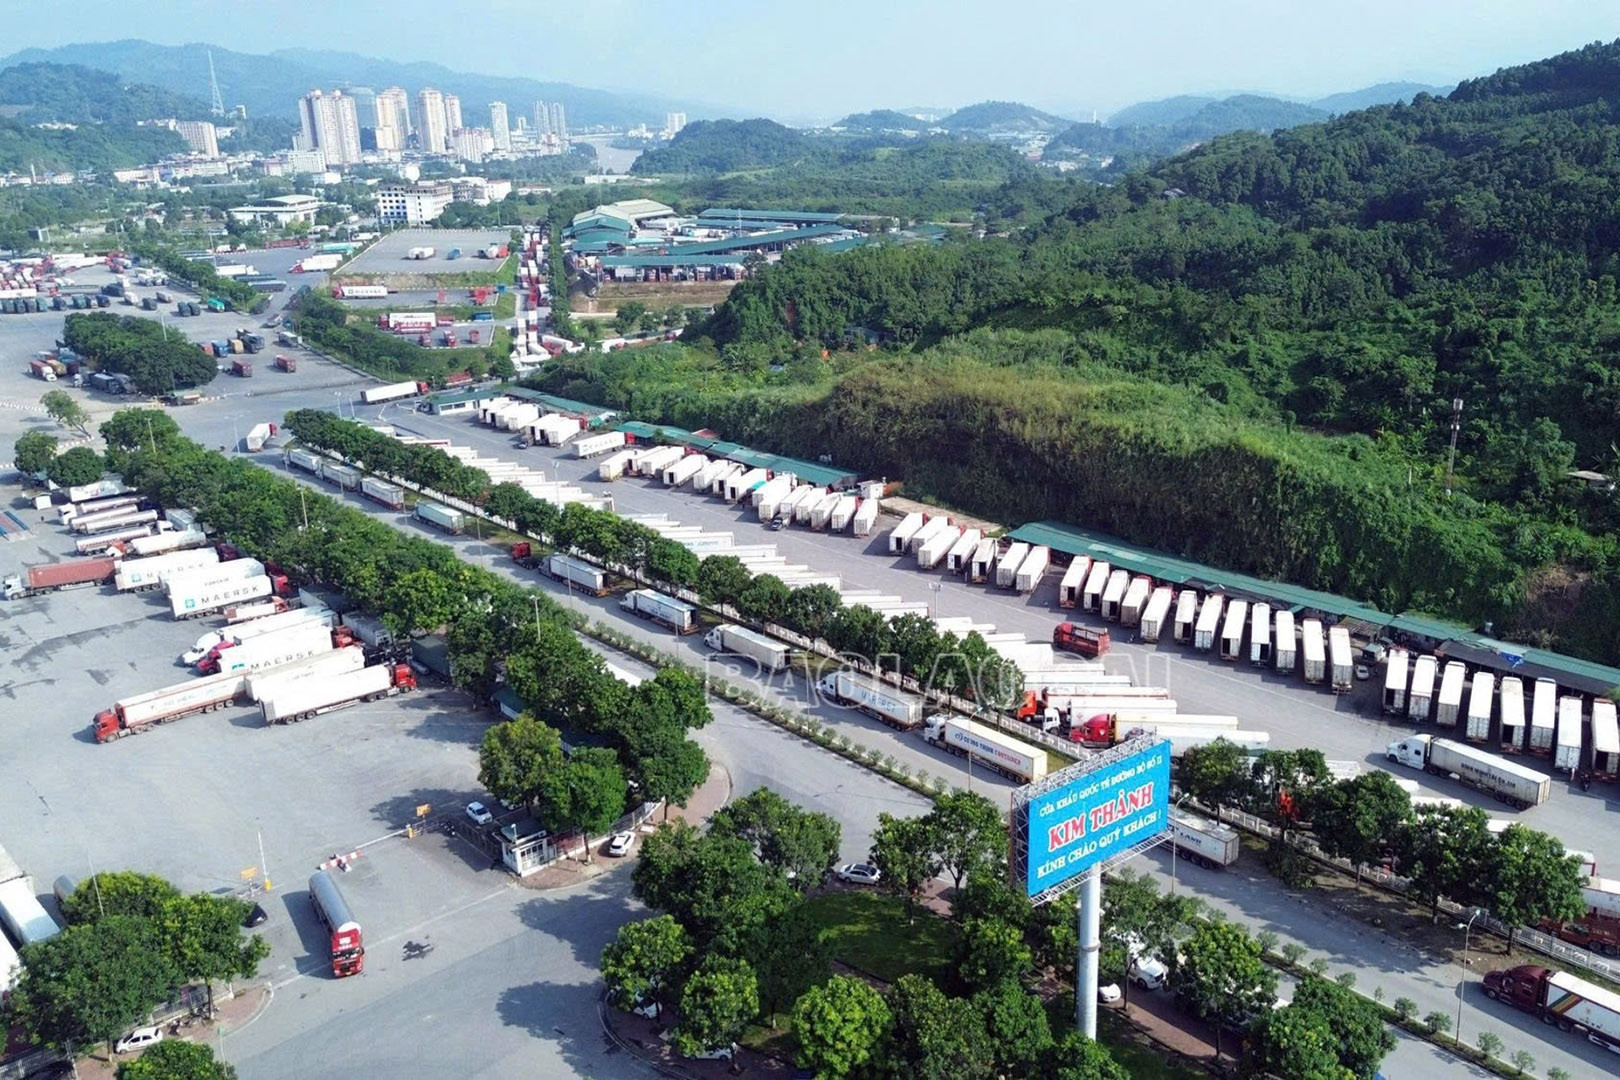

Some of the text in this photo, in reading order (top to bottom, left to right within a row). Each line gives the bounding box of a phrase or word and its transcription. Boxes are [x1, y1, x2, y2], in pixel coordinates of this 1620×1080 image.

[201, 585, 259, 604] MAERSK
[250, 650, 315, 670] MAERSK
[1039, 800, 1055, 817] CỬA
[1080, 782, 1099, 799] QUỐC
[1100, 776, 1111, 790] TẾ
[1036, 855, 1066, 879] KÍNH
[1067, 840, 1097, 863] CHÀO
[1098, 826, 1121, 848] QUÝ
[1123, 811, 1158, 836] KHÁCH
[1048, 812, 1087, 853] KIM
